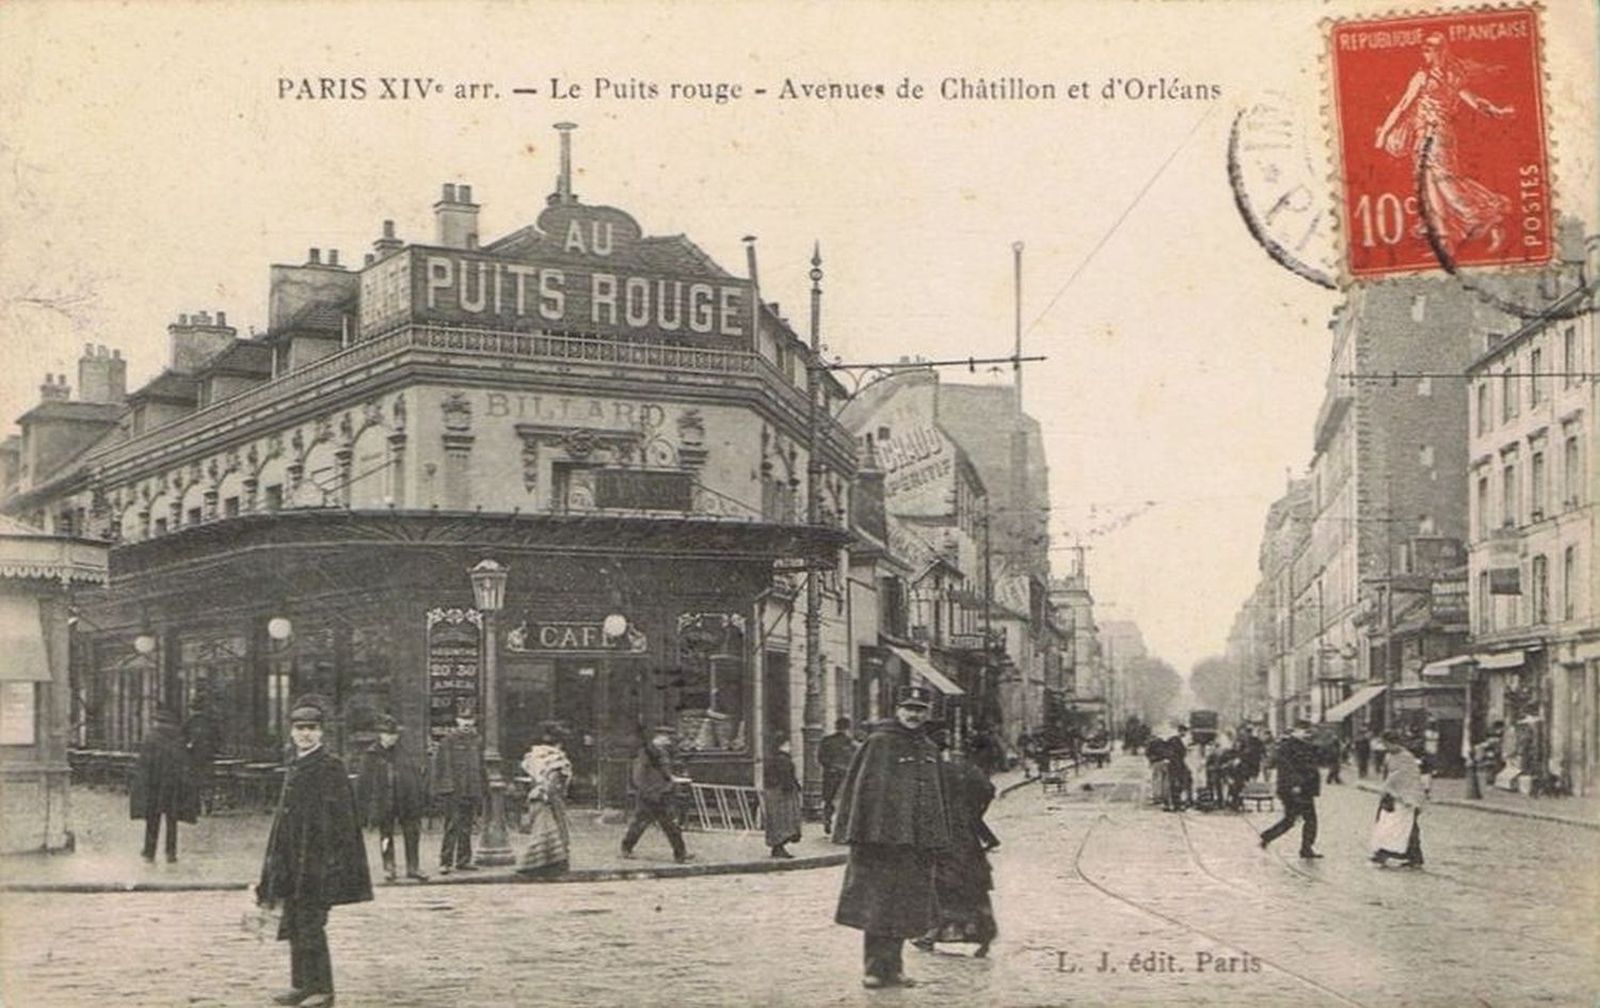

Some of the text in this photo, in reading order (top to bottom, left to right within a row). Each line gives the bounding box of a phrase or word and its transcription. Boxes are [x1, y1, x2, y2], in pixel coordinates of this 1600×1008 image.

[565, 219, 613, 256] AU
[1519, 164, 1543, 247] POSTES
[425, 256, 743, 336] PUITS ROUGE
